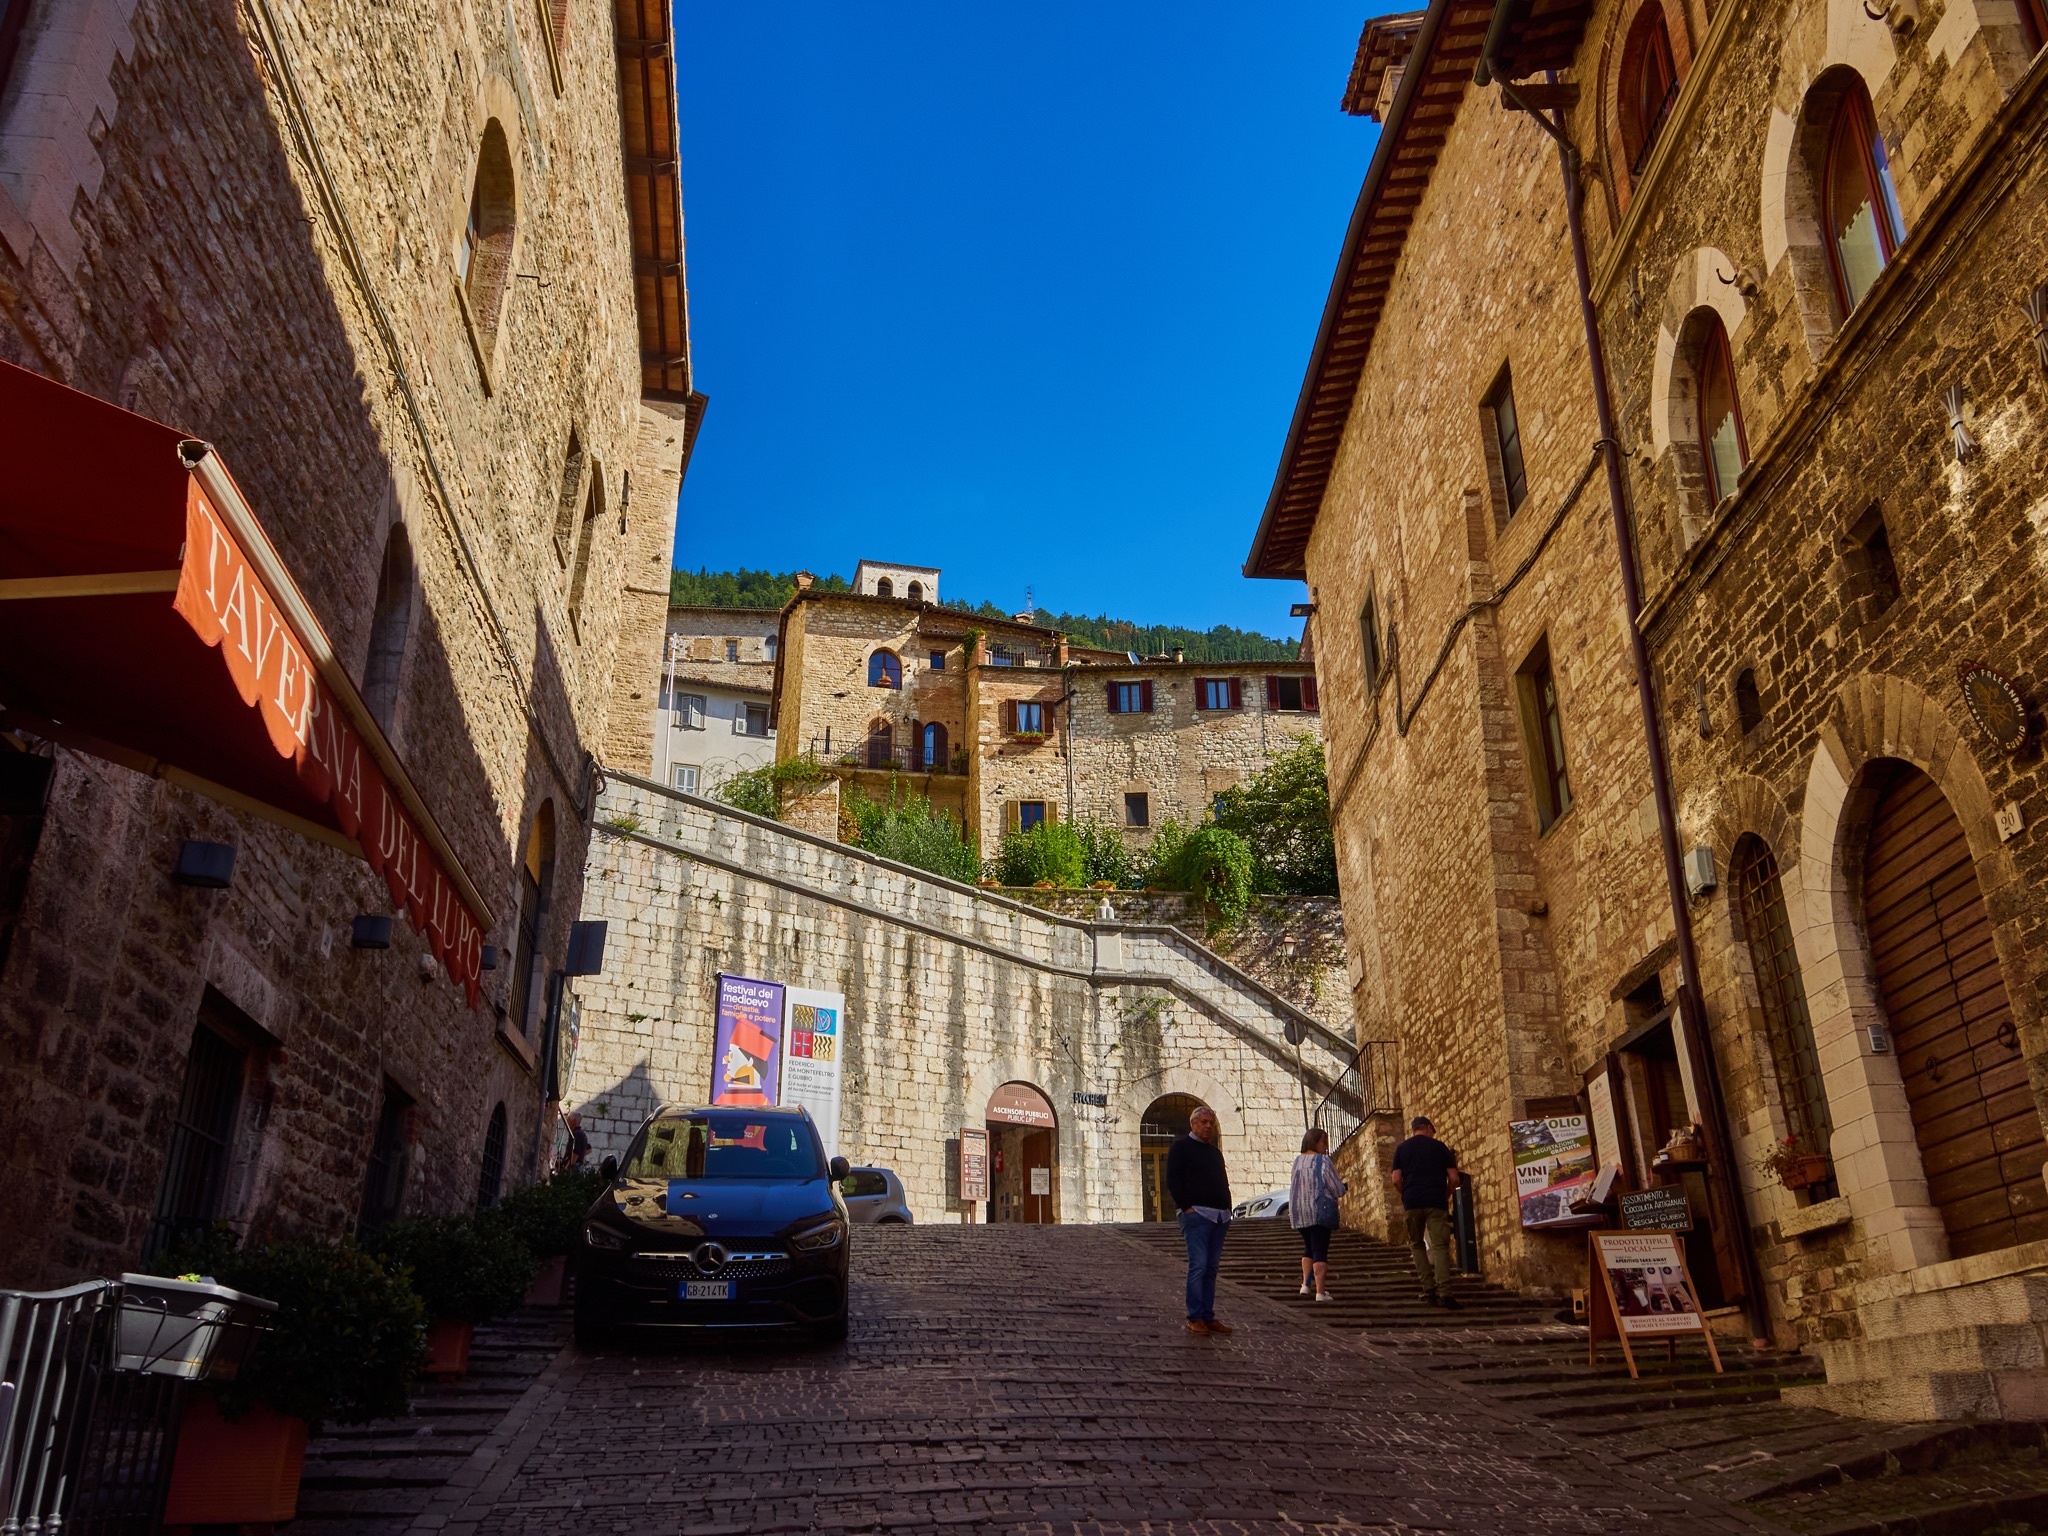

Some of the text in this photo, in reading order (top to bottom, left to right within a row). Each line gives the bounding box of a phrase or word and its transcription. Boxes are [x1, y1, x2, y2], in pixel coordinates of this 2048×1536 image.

[1966, 671, 1977, 683] DEI
[1980, 669, 2025, 717] FALEGNAMI
[199, 500, 484, 982] TAVERNA DEL LUPO
[2005, 725, 2026, 750] GUBBIO
[2001, 812, 2015, 831] 20
[723, 982, 773, 999] festival del
[723, 993, 769, 1008] medioevo
[721, 1009, 747, 1019] famiglie
[754, 1015, 776, 1024] potere
[788, 1060, 815, 1068] FEDERICO
[797, 1068, 835, 1077] MONTEFELTRO
[993, 1106, 1049, 1119] ASCENSORI PUBBLICI
[1007, 1114, 1025, 1123] PUBLIC
[1548, 1117, 1581, 1129] OLIO
[1532, 1139, 1575, 1155] DEGUSTAZIONE
[1550, 1143, 1581, 1155] GRATUITA
[1517, 1166, 1547, 1177] VINI
[1621, 1190, 1664, 1205] ASSORTIMENTO
[1654, 1196, 1687, 1209] ARTIGIANALE
[1627, 1216, 1655, 1228] CRESCIA
[1659, 1212, 1686, 1222] GUBBIO
[1660, 1220, 1689, 1230] PIACERE
